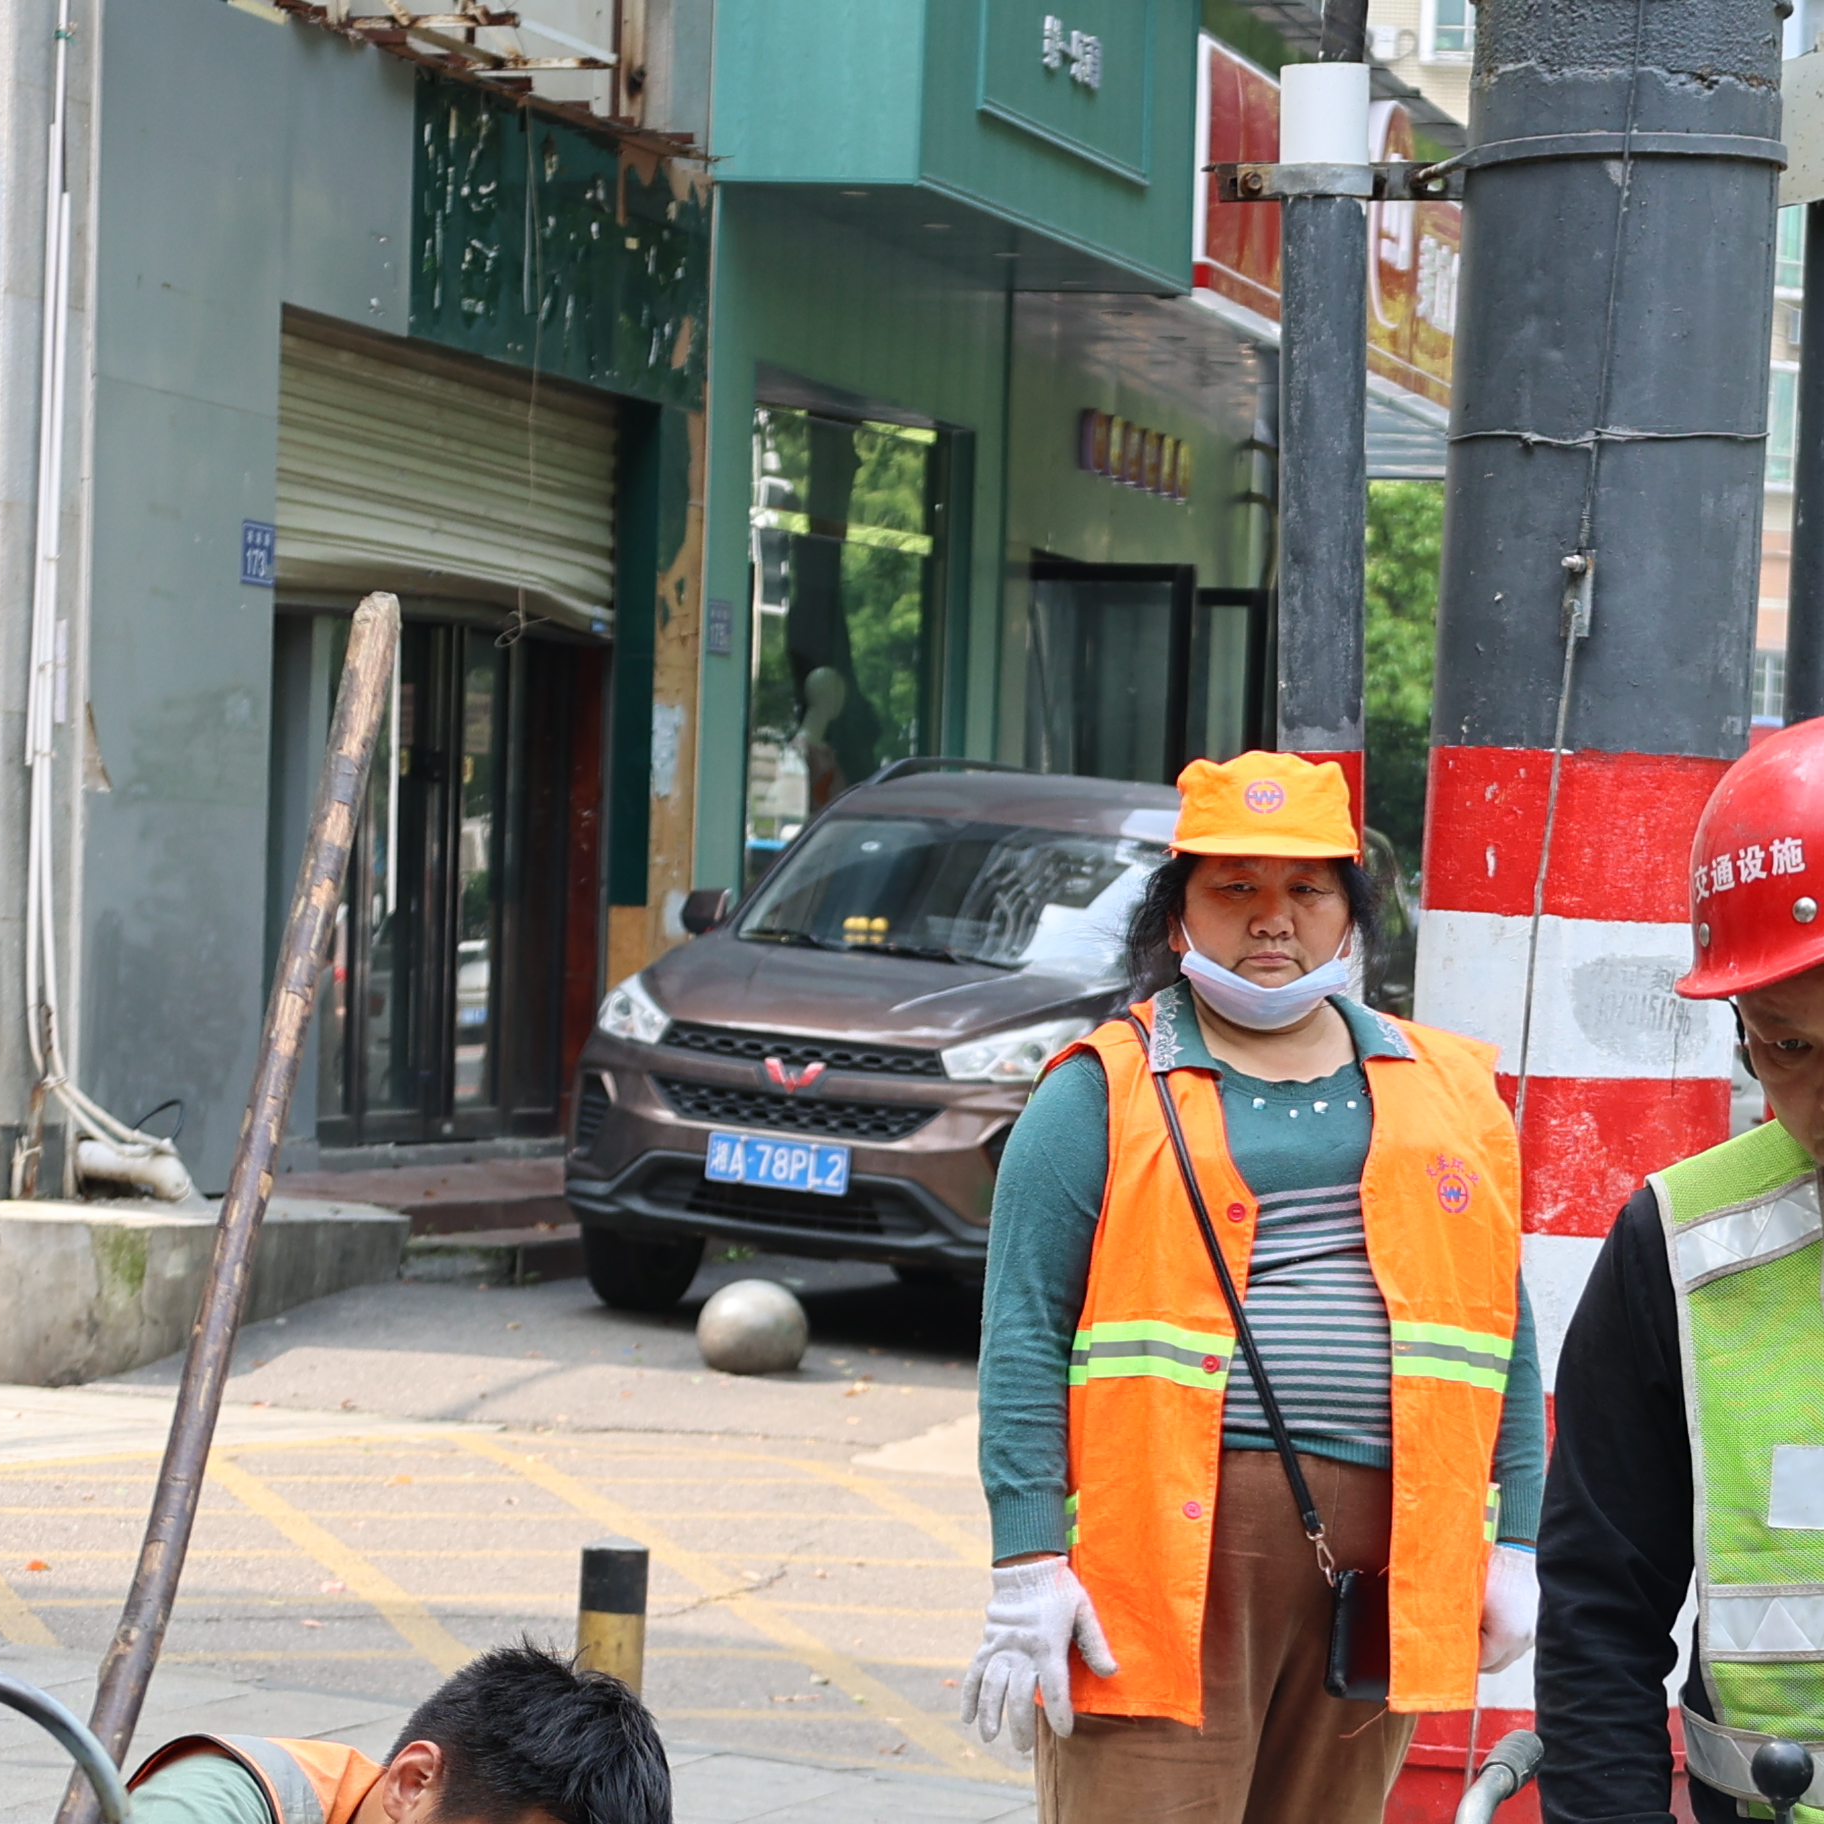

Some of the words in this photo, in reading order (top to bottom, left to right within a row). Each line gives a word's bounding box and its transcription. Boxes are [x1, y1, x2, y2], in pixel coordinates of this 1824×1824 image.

[246, 549, 266, 577] 173
[1694, 837, 1807, 904] 交通设施
